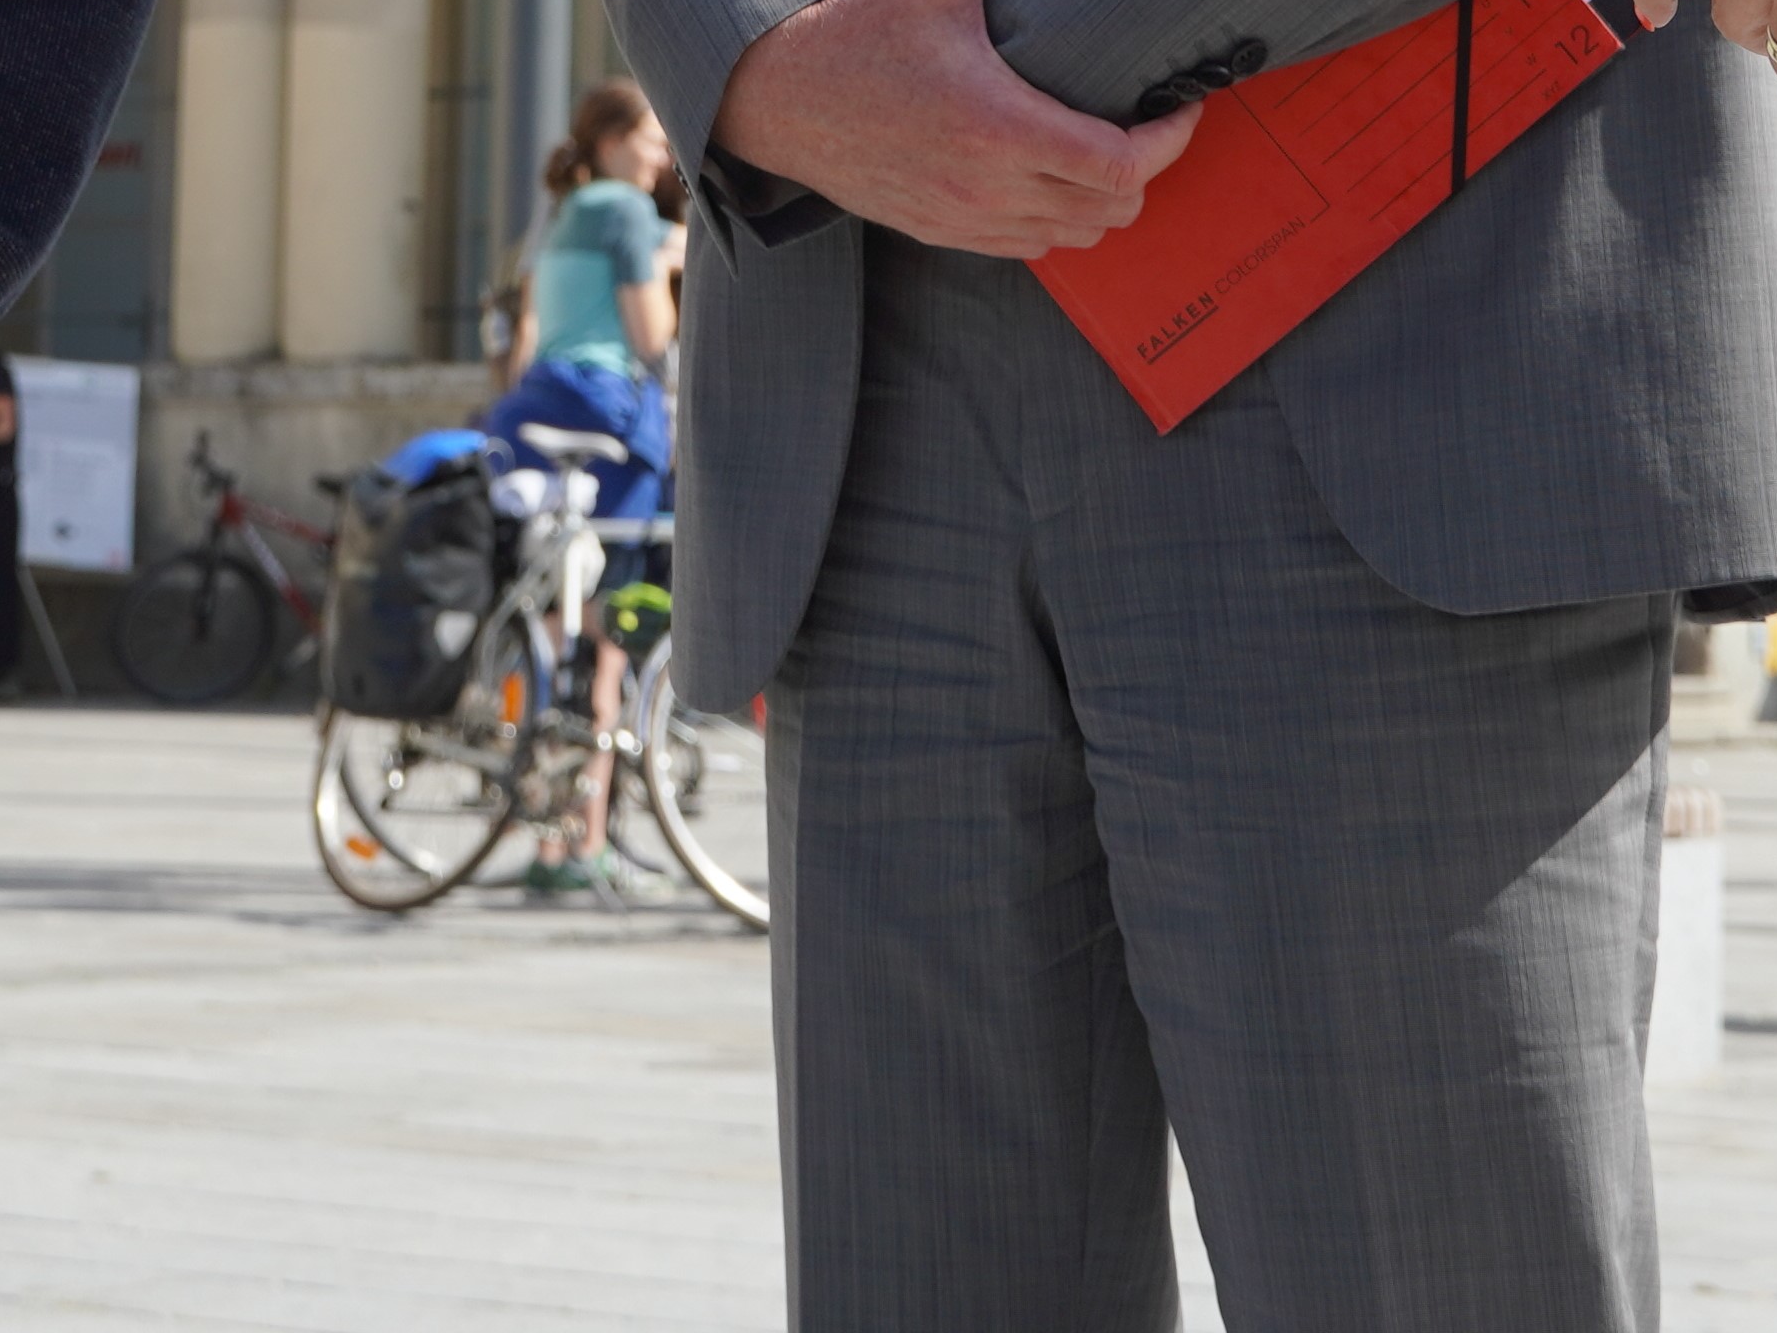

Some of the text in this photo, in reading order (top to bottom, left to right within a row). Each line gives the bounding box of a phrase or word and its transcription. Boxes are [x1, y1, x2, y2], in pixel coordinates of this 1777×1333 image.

[1554, 24, 1600, 65] 12
[1136, 215, 1307, 359] FALKEN COLORSPAN
